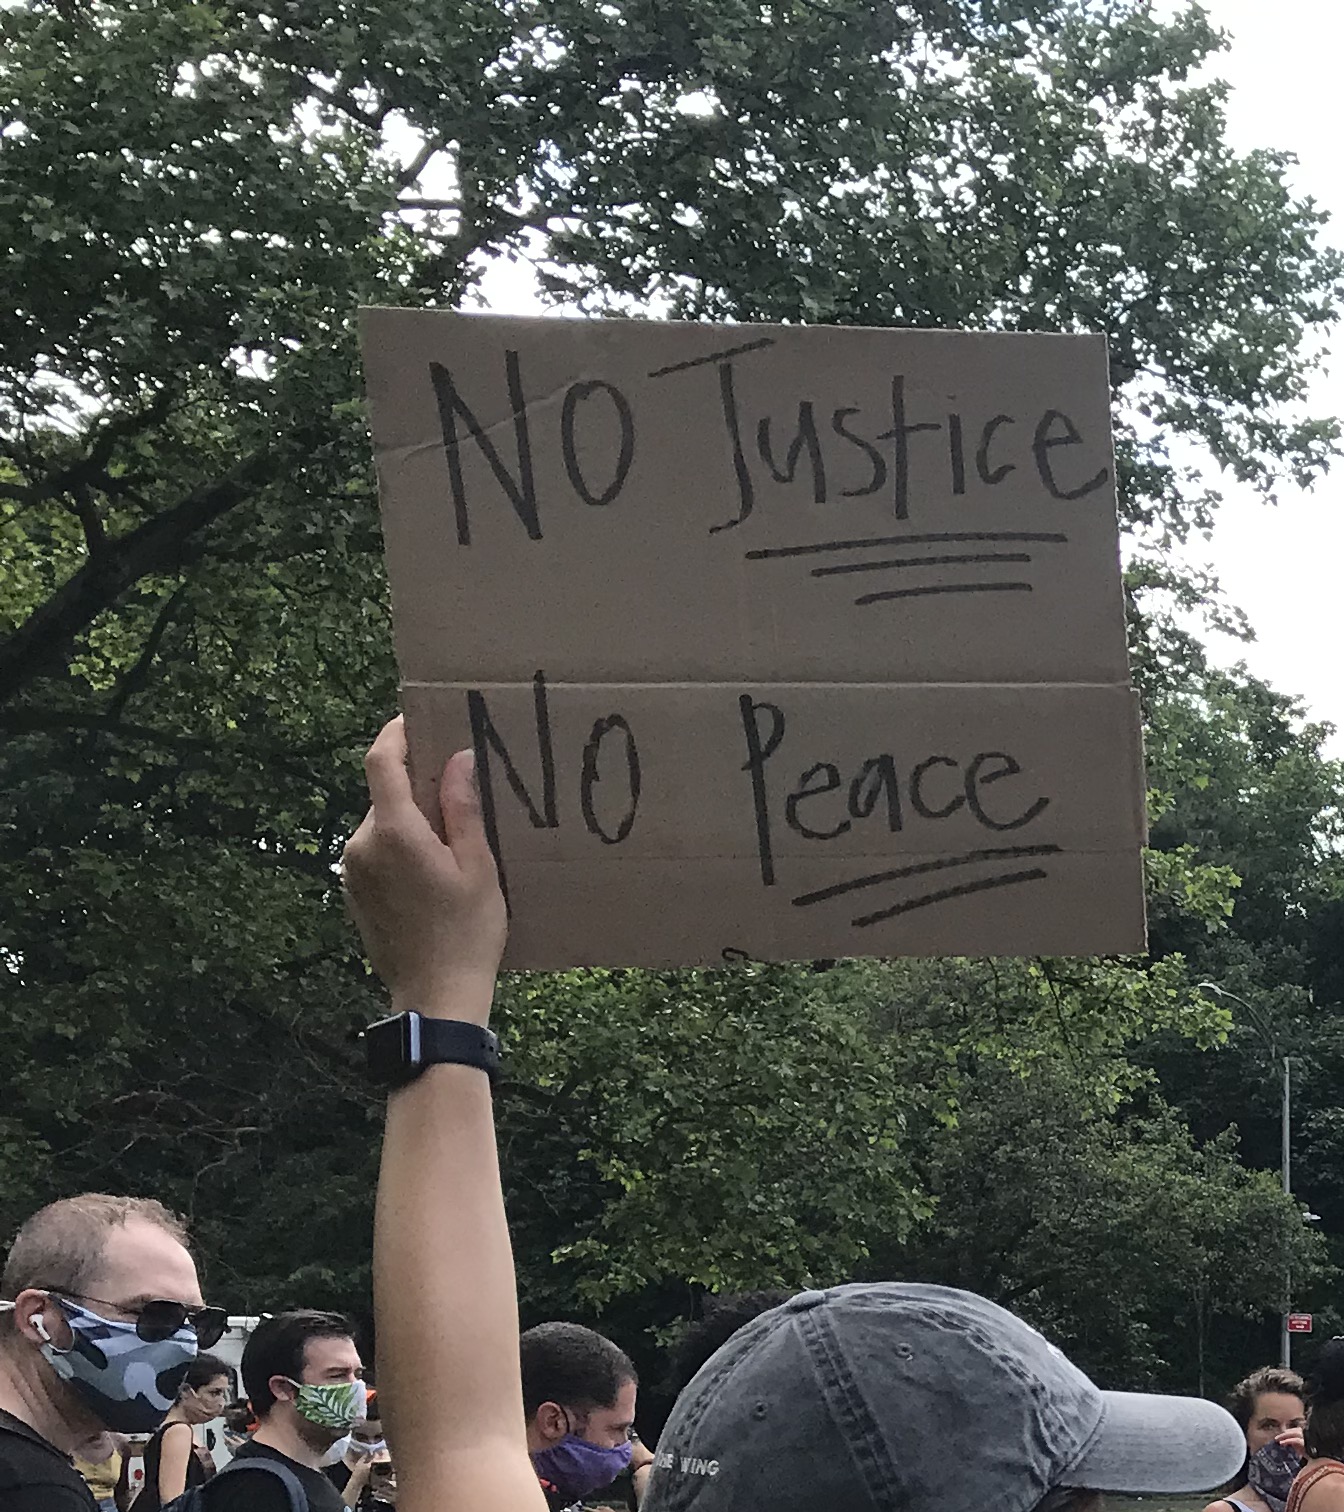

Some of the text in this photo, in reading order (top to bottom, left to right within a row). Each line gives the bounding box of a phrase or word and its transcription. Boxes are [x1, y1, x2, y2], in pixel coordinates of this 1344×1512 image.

[429, 337, 1109, 547] NO Justice
[467, 671, 1050, 919] NO Peace
[657, 1453, 720, 1476] HE WING
